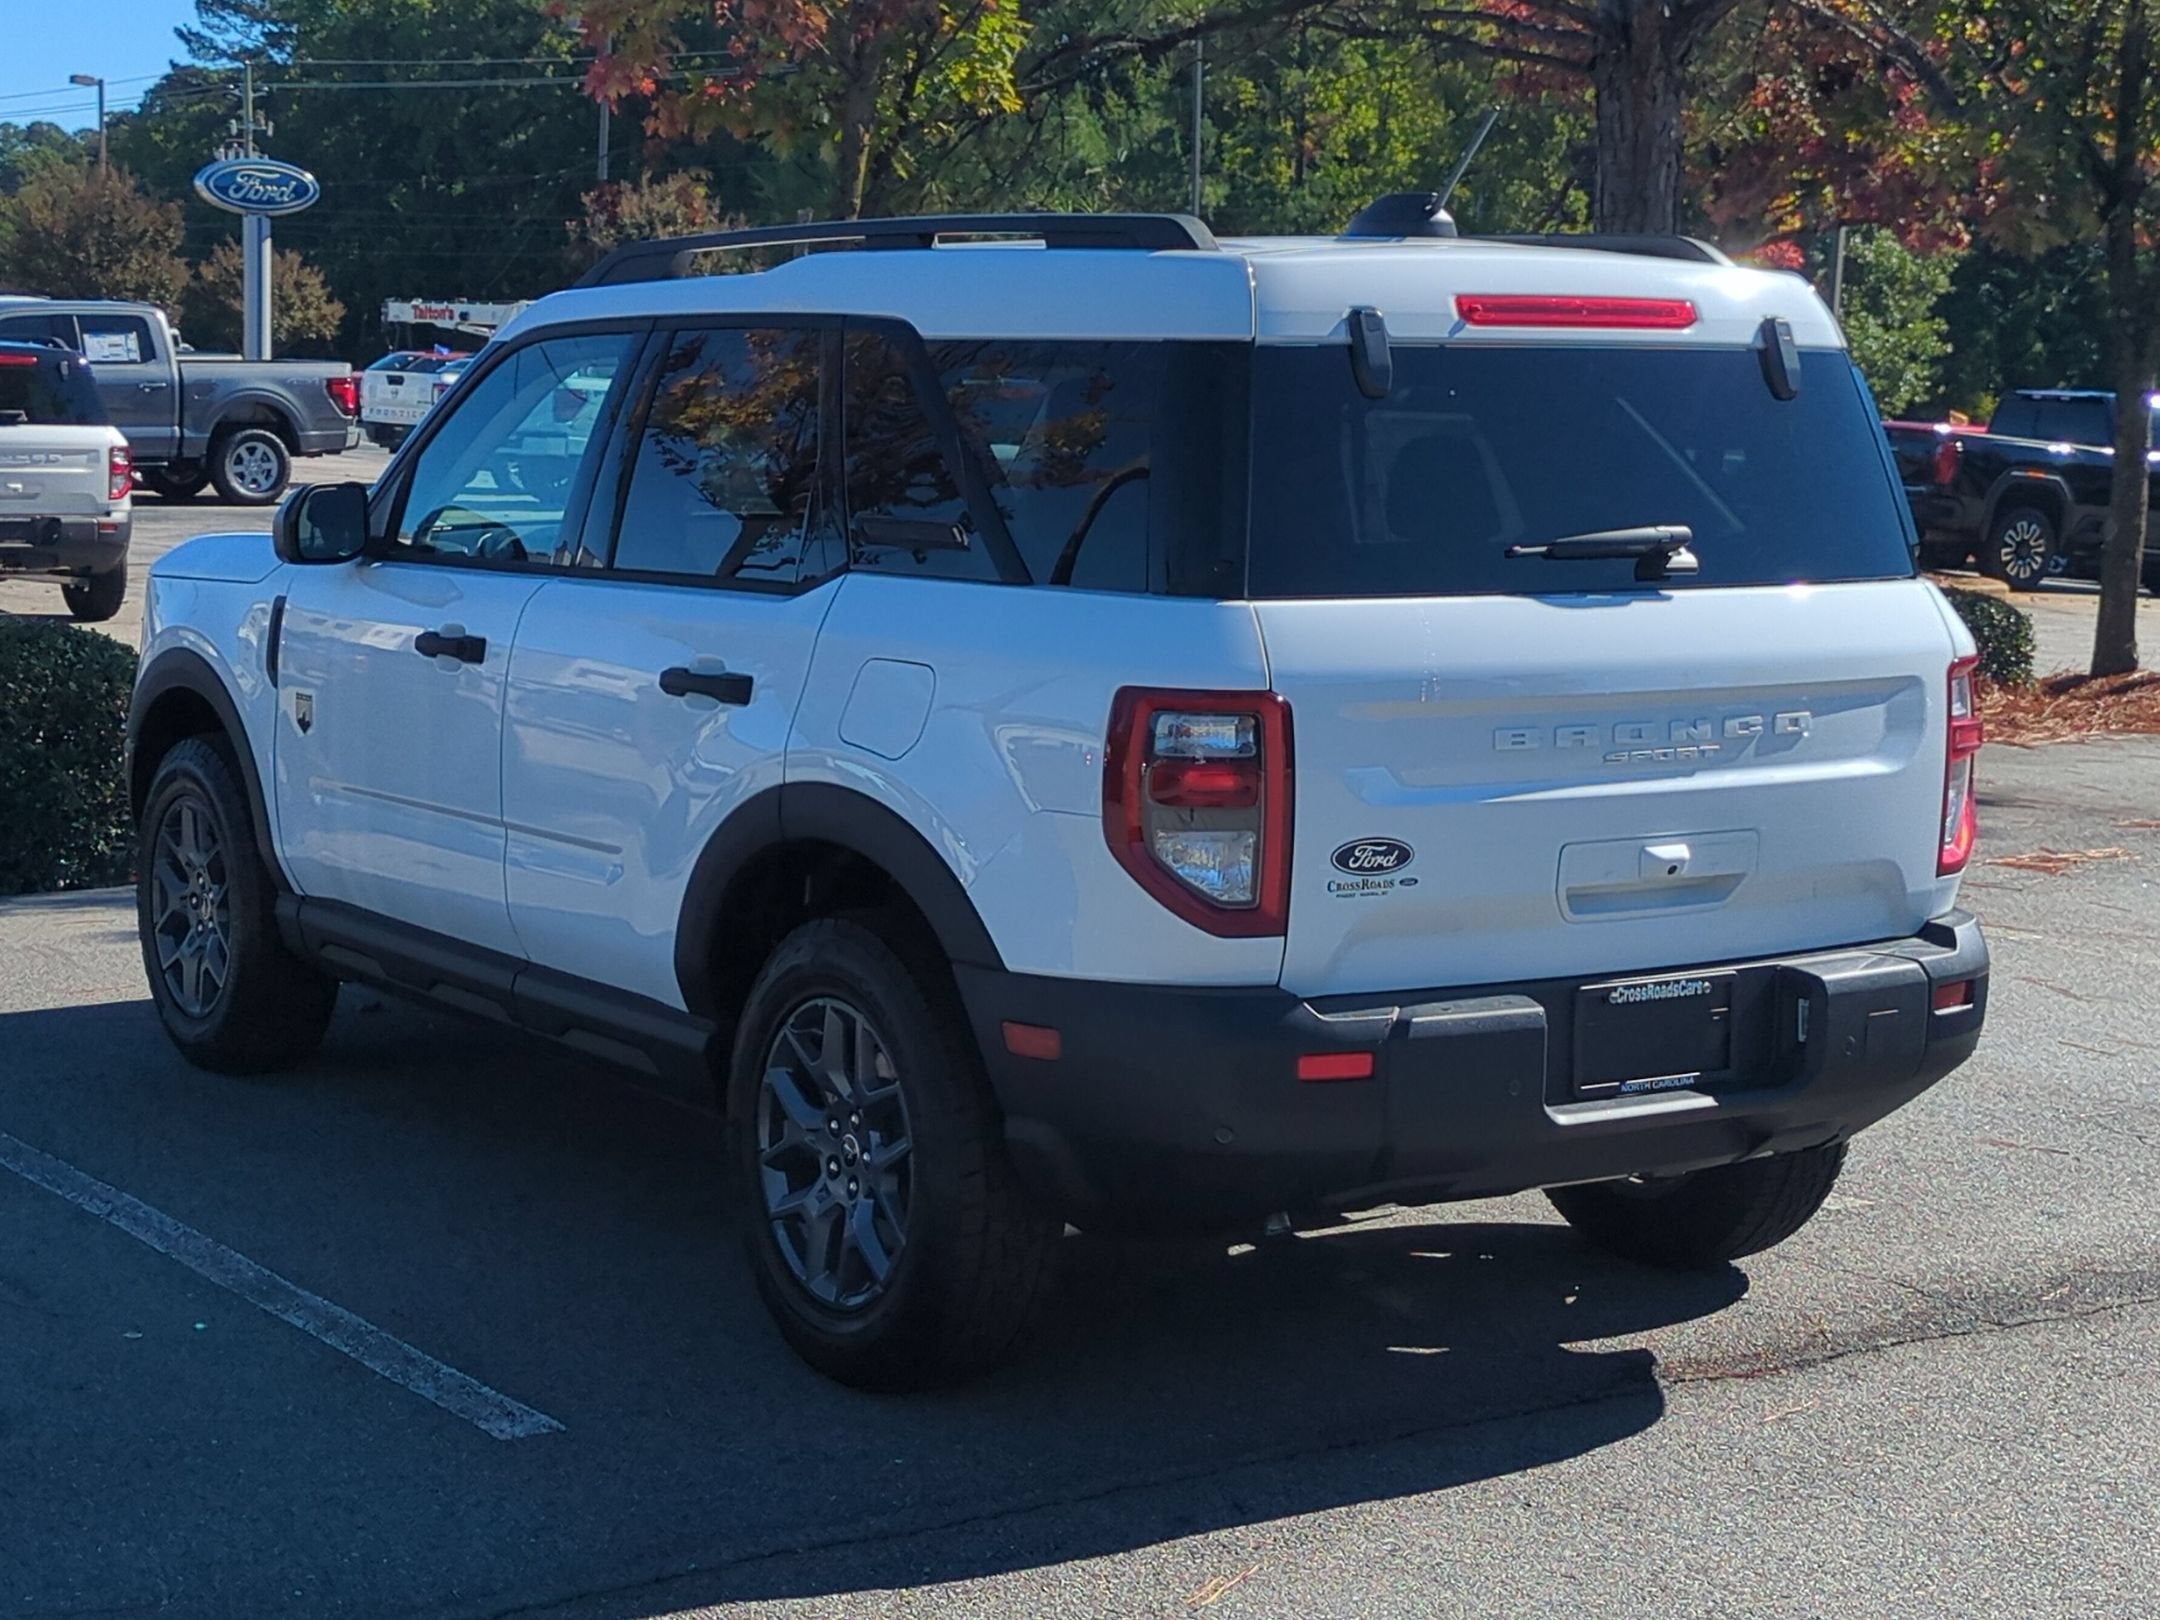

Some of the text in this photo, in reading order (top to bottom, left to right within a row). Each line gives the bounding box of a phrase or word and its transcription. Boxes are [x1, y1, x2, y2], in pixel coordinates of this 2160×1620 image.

[228, 170, 298, 202] Ford
[1493, 711, 1813, 750] BRONCO
[1602, 744, 1721, 765] SPORT
[1348, 845, 1399, 869] Ford
[1620, 1076, 1695, 1093] NORTH CAROLINA
